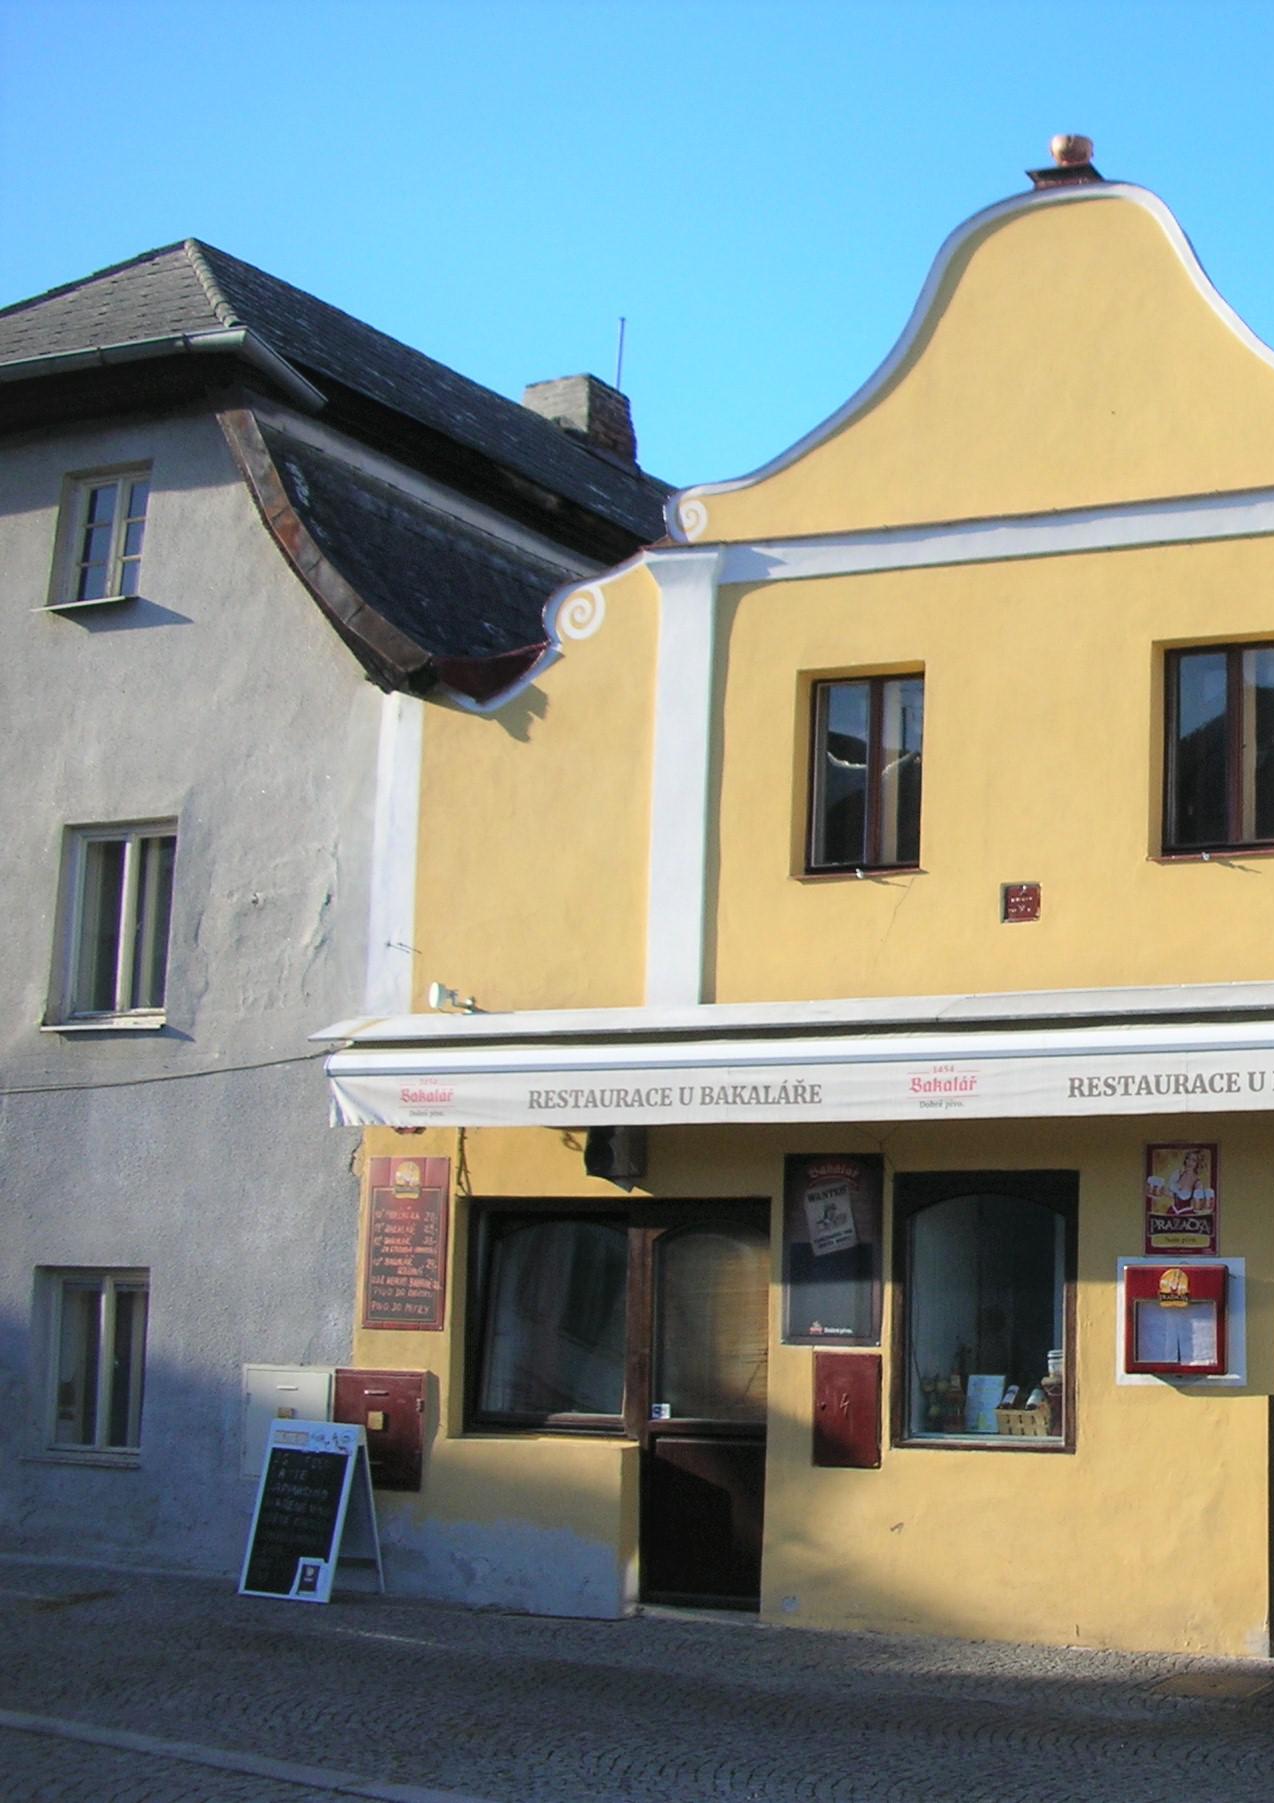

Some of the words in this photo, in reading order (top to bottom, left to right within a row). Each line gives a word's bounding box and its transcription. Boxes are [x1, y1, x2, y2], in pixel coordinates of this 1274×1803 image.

[528, 1087, 673, 1109] RESTAURACE
[679, 1086, 695, 1106] U
[700, 1079, 823, 1105] BAKALÁŘE
[910, 1075, 977, 1093] Bakalář
[1068, 1072, 1241, 1098] RESTAURACE
[1247, 1071, 1266, 1093] U
